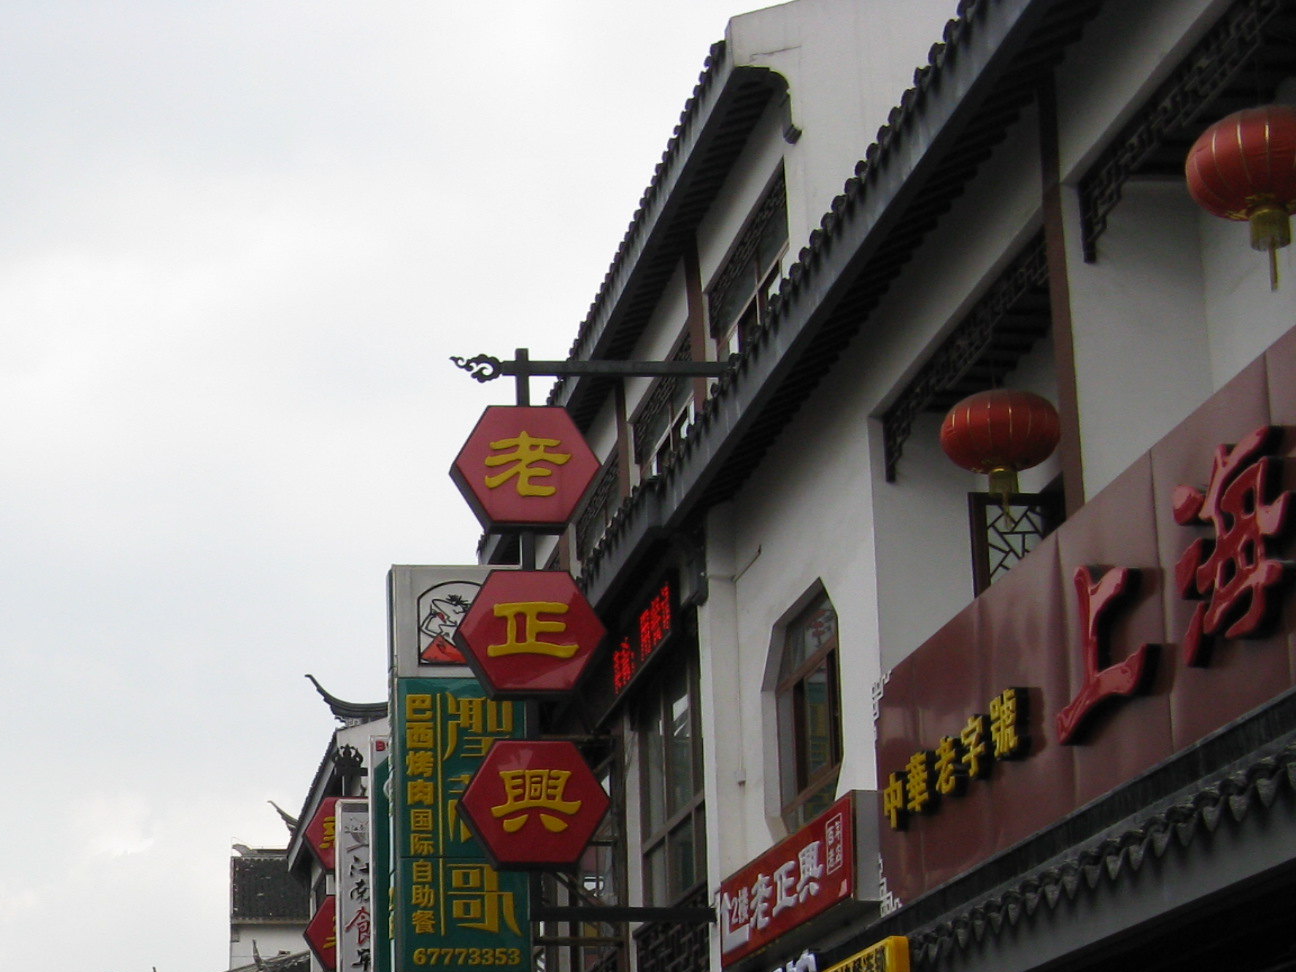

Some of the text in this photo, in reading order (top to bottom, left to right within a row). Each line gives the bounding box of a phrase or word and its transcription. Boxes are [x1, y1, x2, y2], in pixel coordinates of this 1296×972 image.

[405, 693, 436, 935] 巴西烤肉国际自助餐
[413, 948, 521, 966] 67773353
